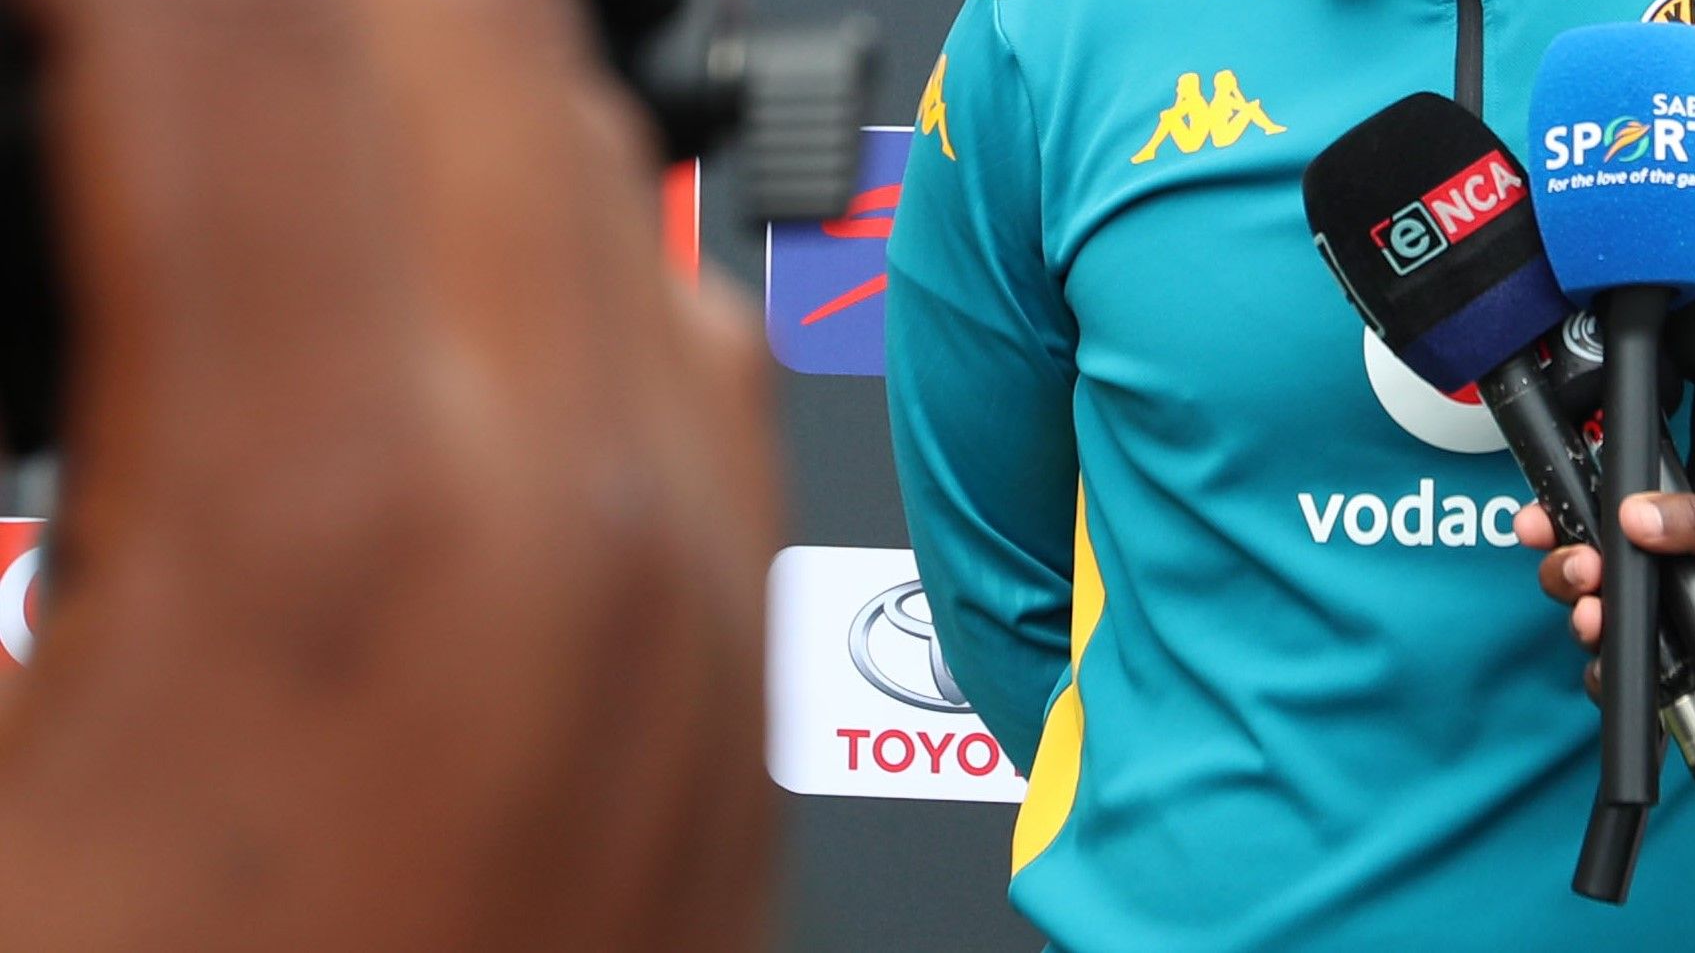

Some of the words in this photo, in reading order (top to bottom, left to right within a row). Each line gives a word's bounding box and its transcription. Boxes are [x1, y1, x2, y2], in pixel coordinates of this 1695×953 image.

[1571, 173, 1594, 189] the
[1597, 170, 1628, 186] love
[1630, 167, 1649, 184] of
[1650, 167, 1676, 185] the
[1297, 478, 1538, 547] vodac
[837, 729, 1022, 777] TOYO
